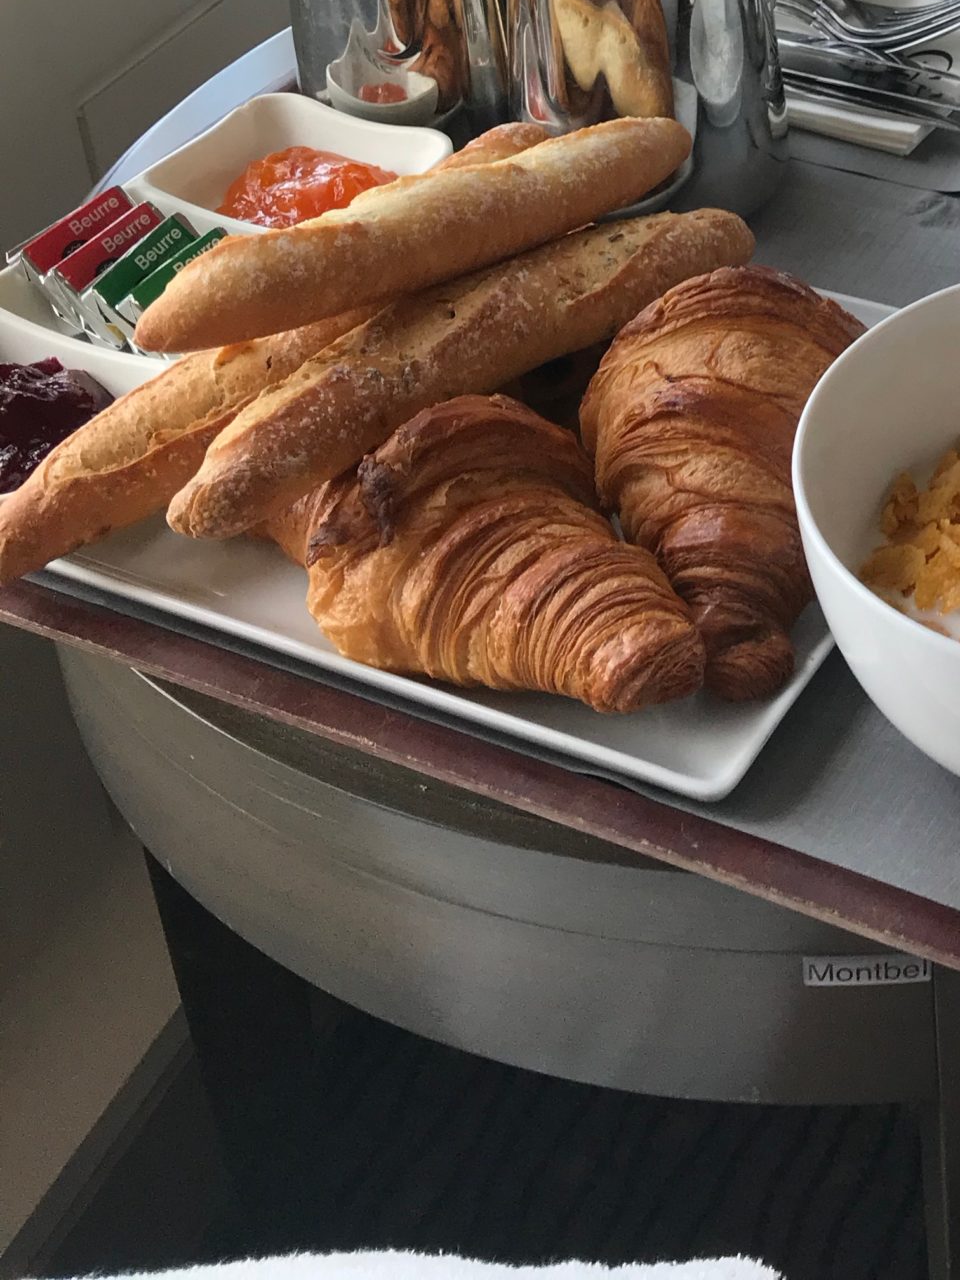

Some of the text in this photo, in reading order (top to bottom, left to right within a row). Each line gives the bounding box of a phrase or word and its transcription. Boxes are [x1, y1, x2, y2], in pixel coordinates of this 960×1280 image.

[68, 195, 120, 236] Beurre
[101, 212, 151, 253] Beurre
[134, 227, 182, 271] Beurre
[808, 958, 928, 982] Montbel
